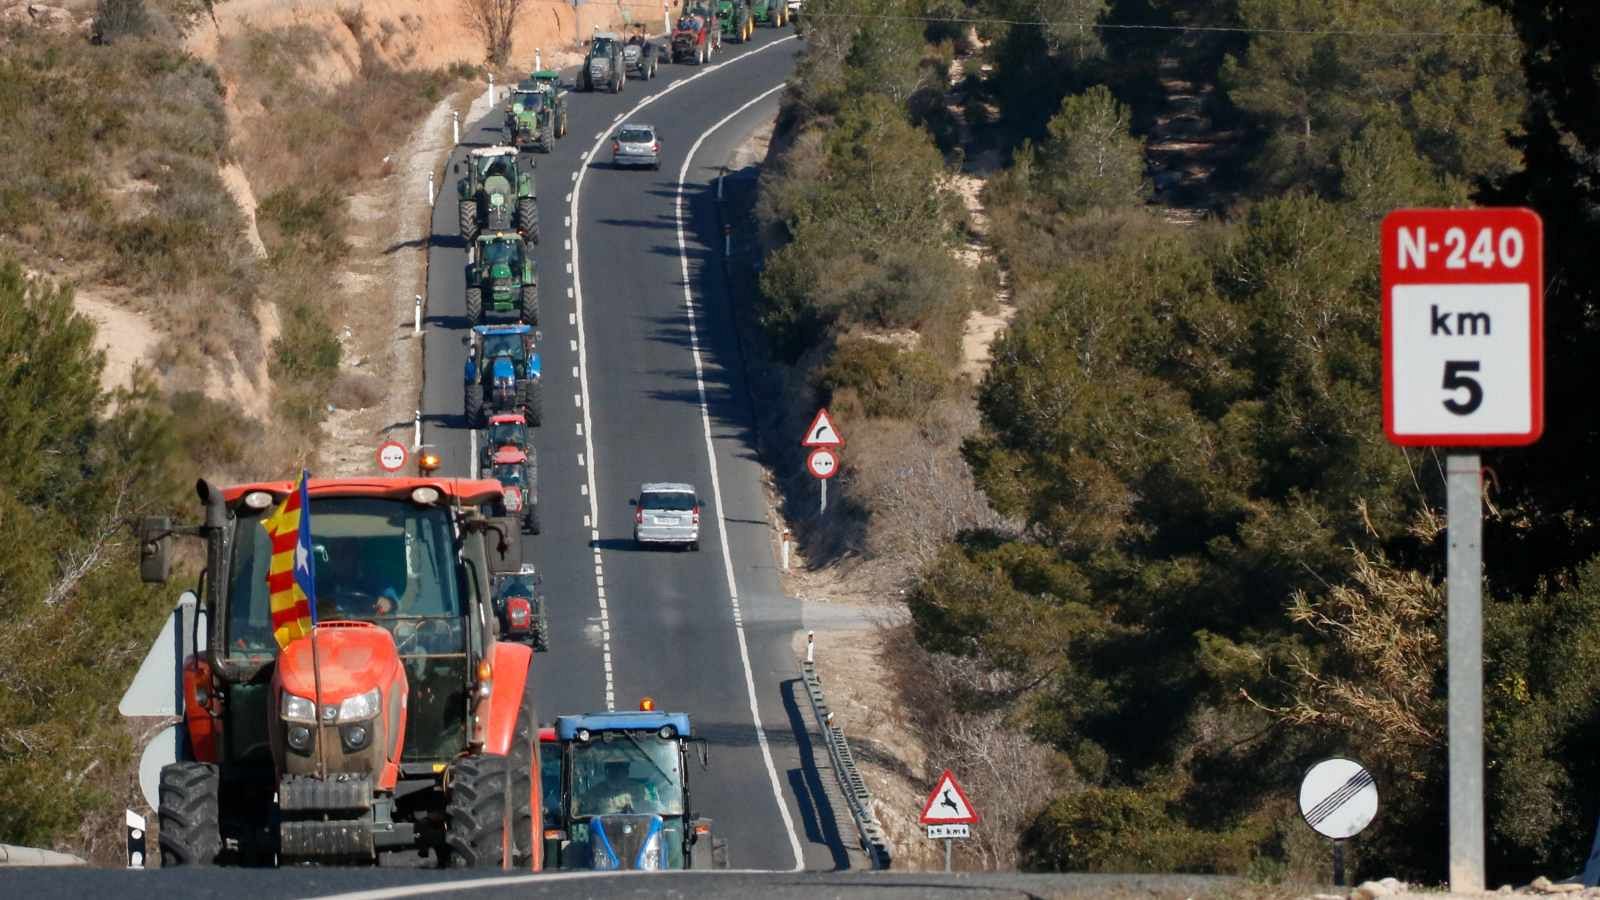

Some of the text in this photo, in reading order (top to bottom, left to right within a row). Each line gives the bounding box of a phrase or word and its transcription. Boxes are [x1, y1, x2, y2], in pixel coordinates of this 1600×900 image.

[1397, 226, 1524, 269] N-240
[1430, 304, 1491, 336] km
[1442, 360, 1484, 416] 5
